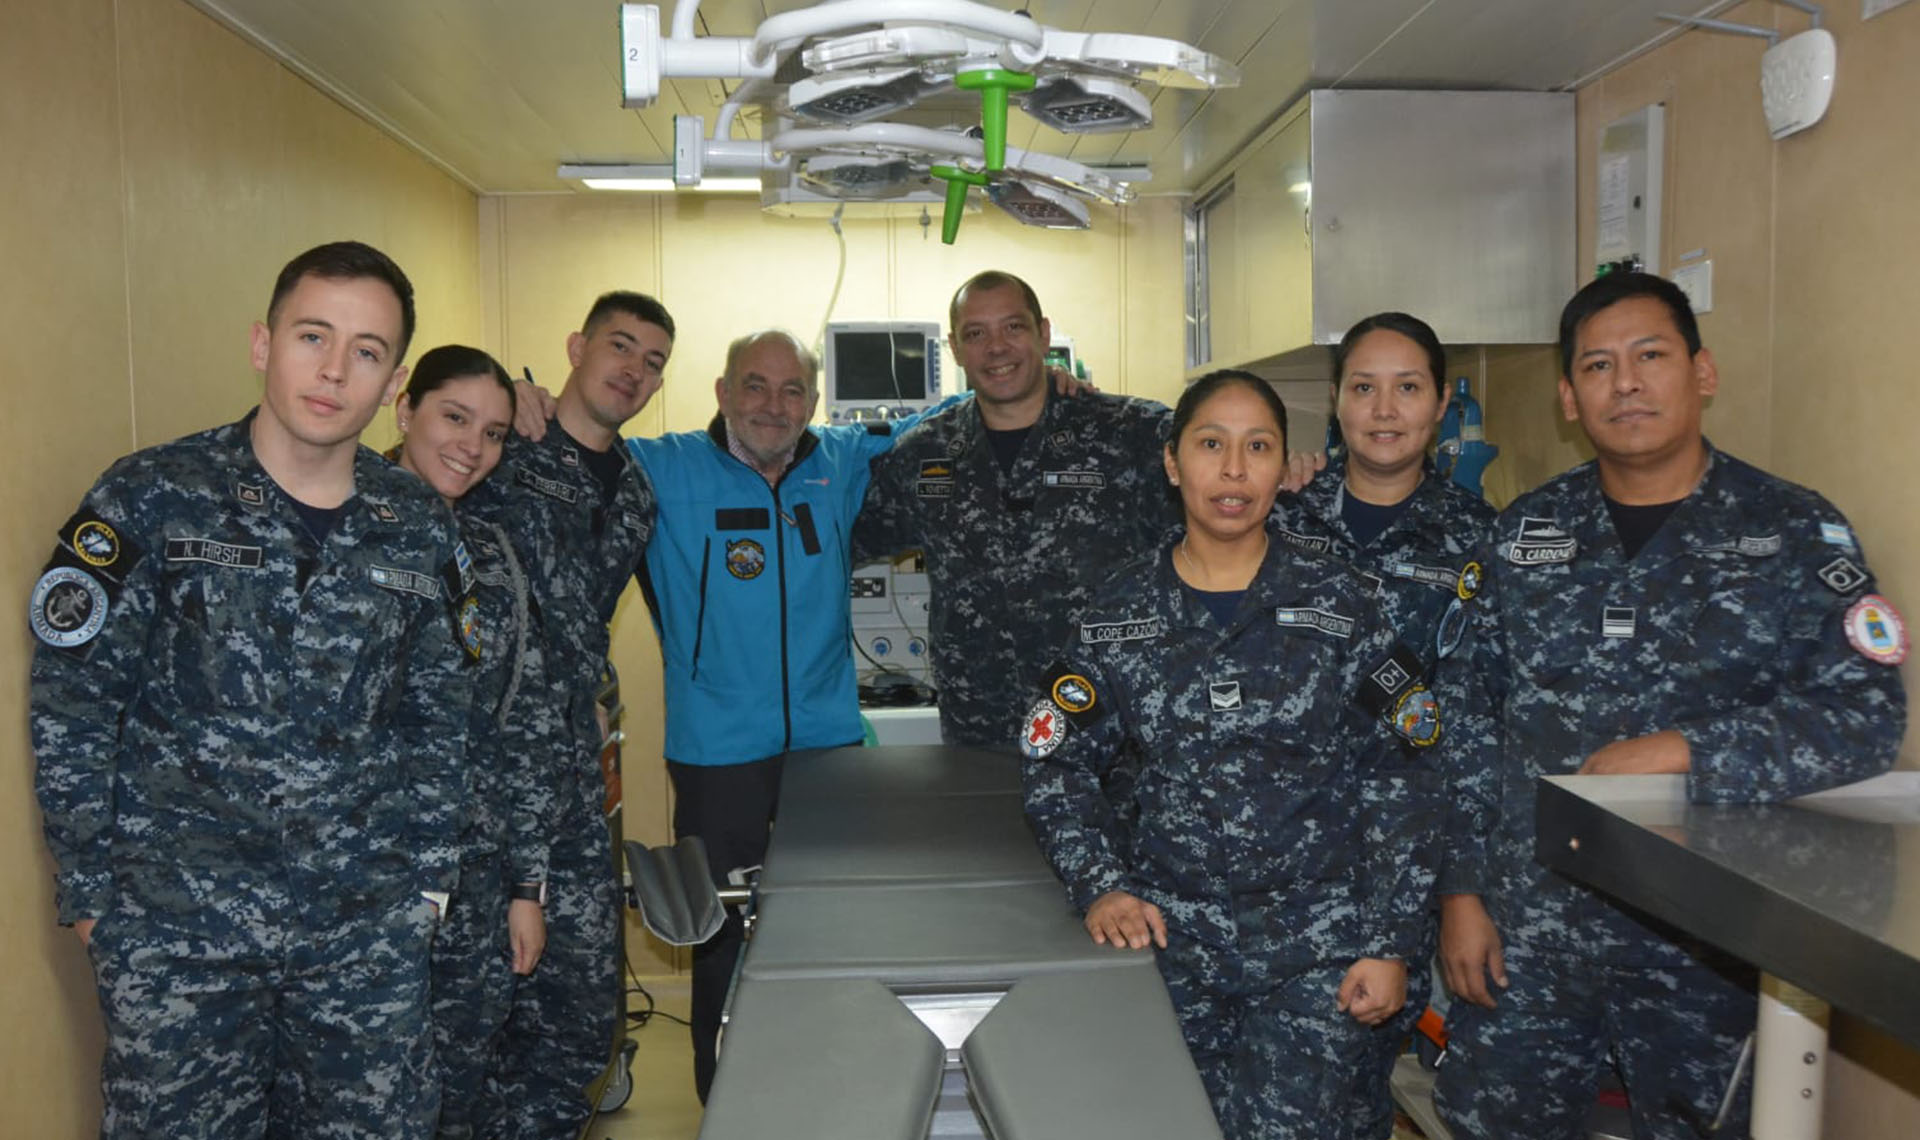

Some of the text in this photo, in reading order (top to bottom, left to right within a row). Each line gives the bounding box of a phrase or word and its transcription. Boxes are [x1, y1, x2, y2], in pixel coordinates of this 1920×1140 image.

[629, 48, 638, 61] 2
[680, 148, 684, 158] 1
[183, 541, 241, 564] N. HIRSH
[1513, 548, 1524, 560] D.
[33, 605, 63, 643] ARMADA
[1097, 627, 1123, 640] COPE
